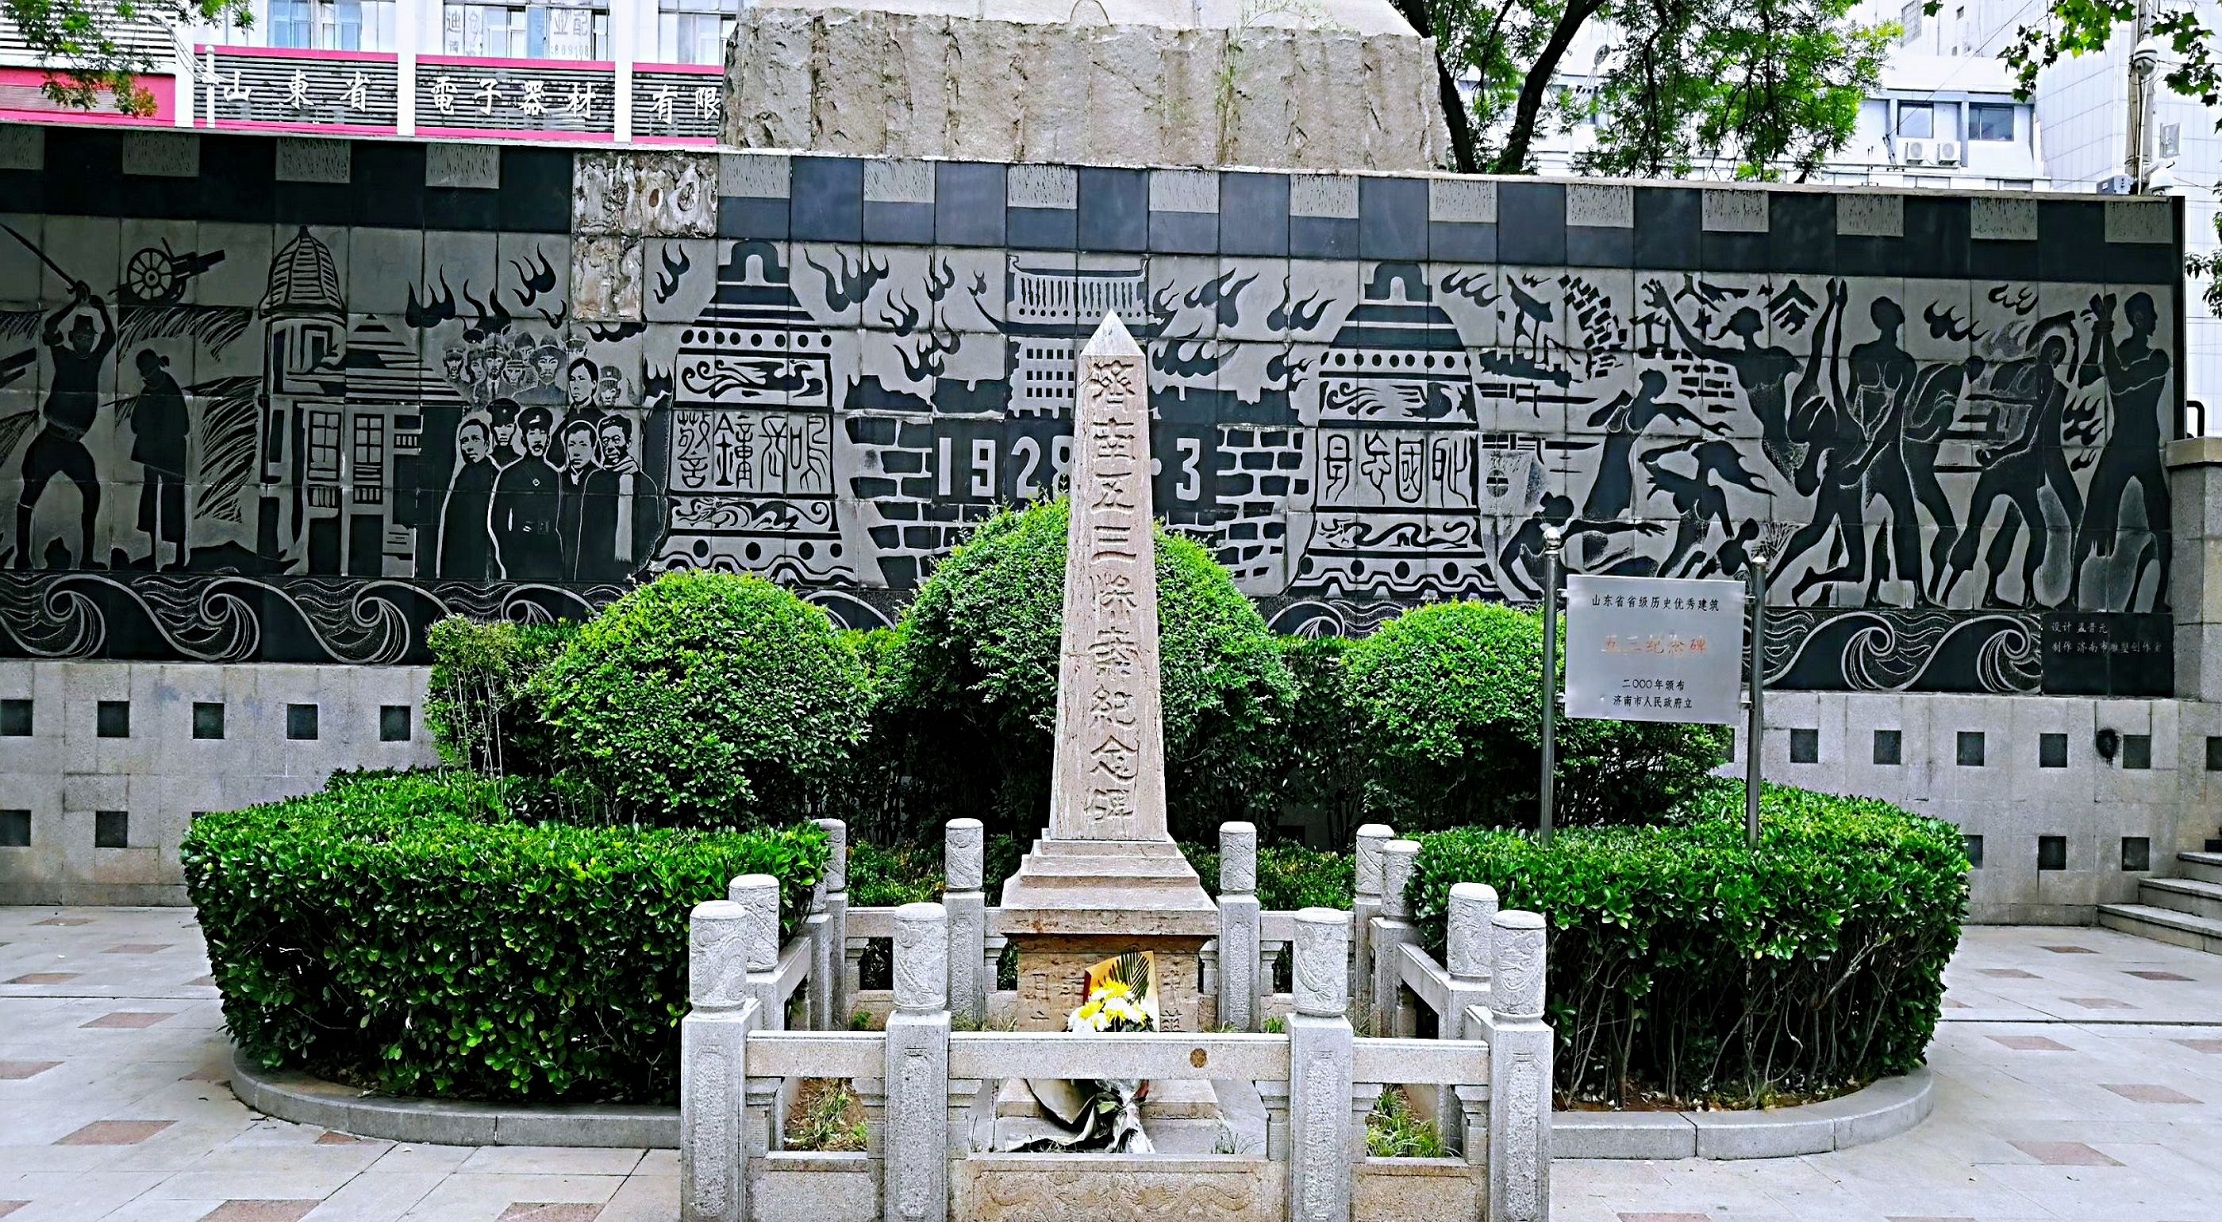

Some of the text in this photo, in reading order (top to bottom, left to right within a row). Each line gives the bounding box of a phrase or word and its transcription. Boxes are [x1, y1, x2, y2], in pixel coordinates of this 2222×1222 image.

[1592, 594, 1719, 612] 山东省省级历史优秀建筑
[1613, 695, 1693, 709] 济南市人民政府立
